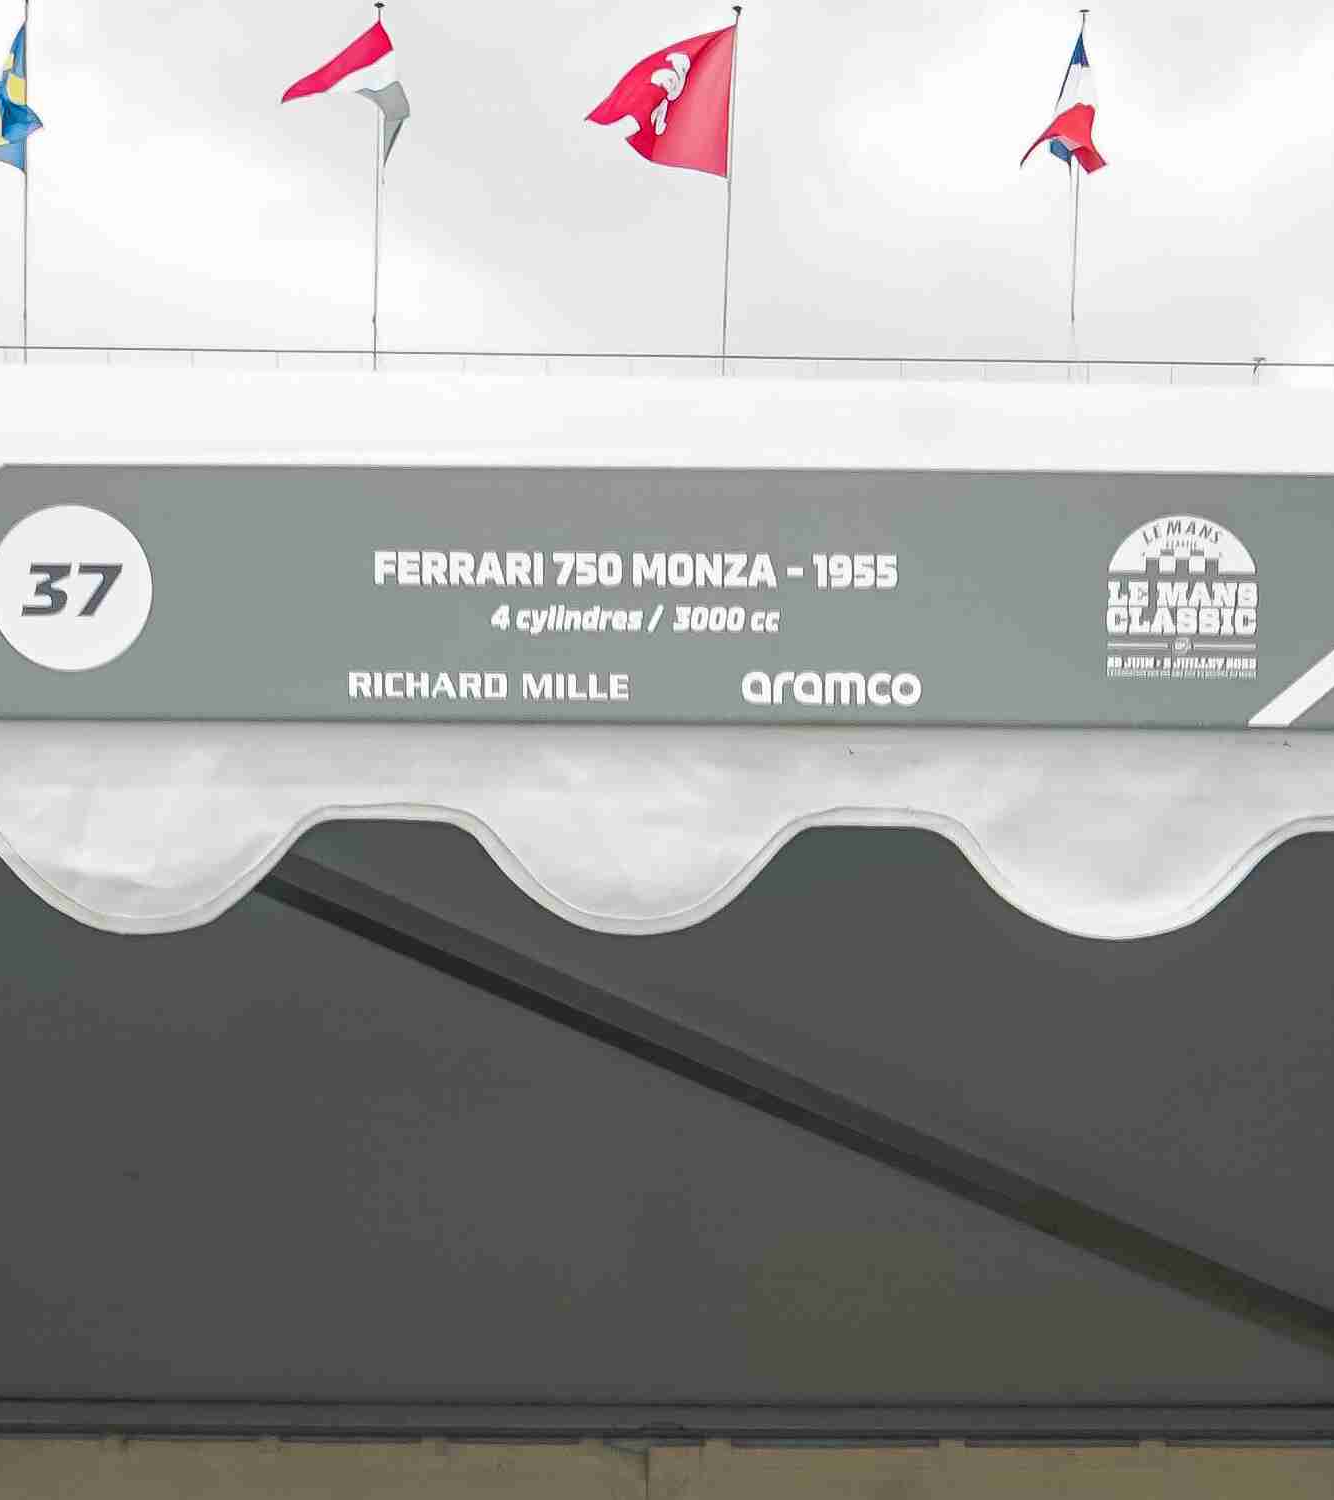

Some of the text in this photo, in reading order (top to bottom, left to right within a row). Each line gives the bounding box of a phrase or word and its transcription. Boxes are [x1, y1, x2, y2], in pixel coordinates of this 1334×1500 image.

[374, 551, 898, 590] FERRARI 750 MONZA - 1955
[20, 562, 123, 618] 37
[1107, 581, 1258, 608] LE MANS
[490, 604, 781, 635] 4 cylindres / 3000 cc
[1106, 607, 1258, 635] CLASSIC
[347, 671, 632, 702] RICHARD MILLE
[740, 671, 924, 706] aramco
